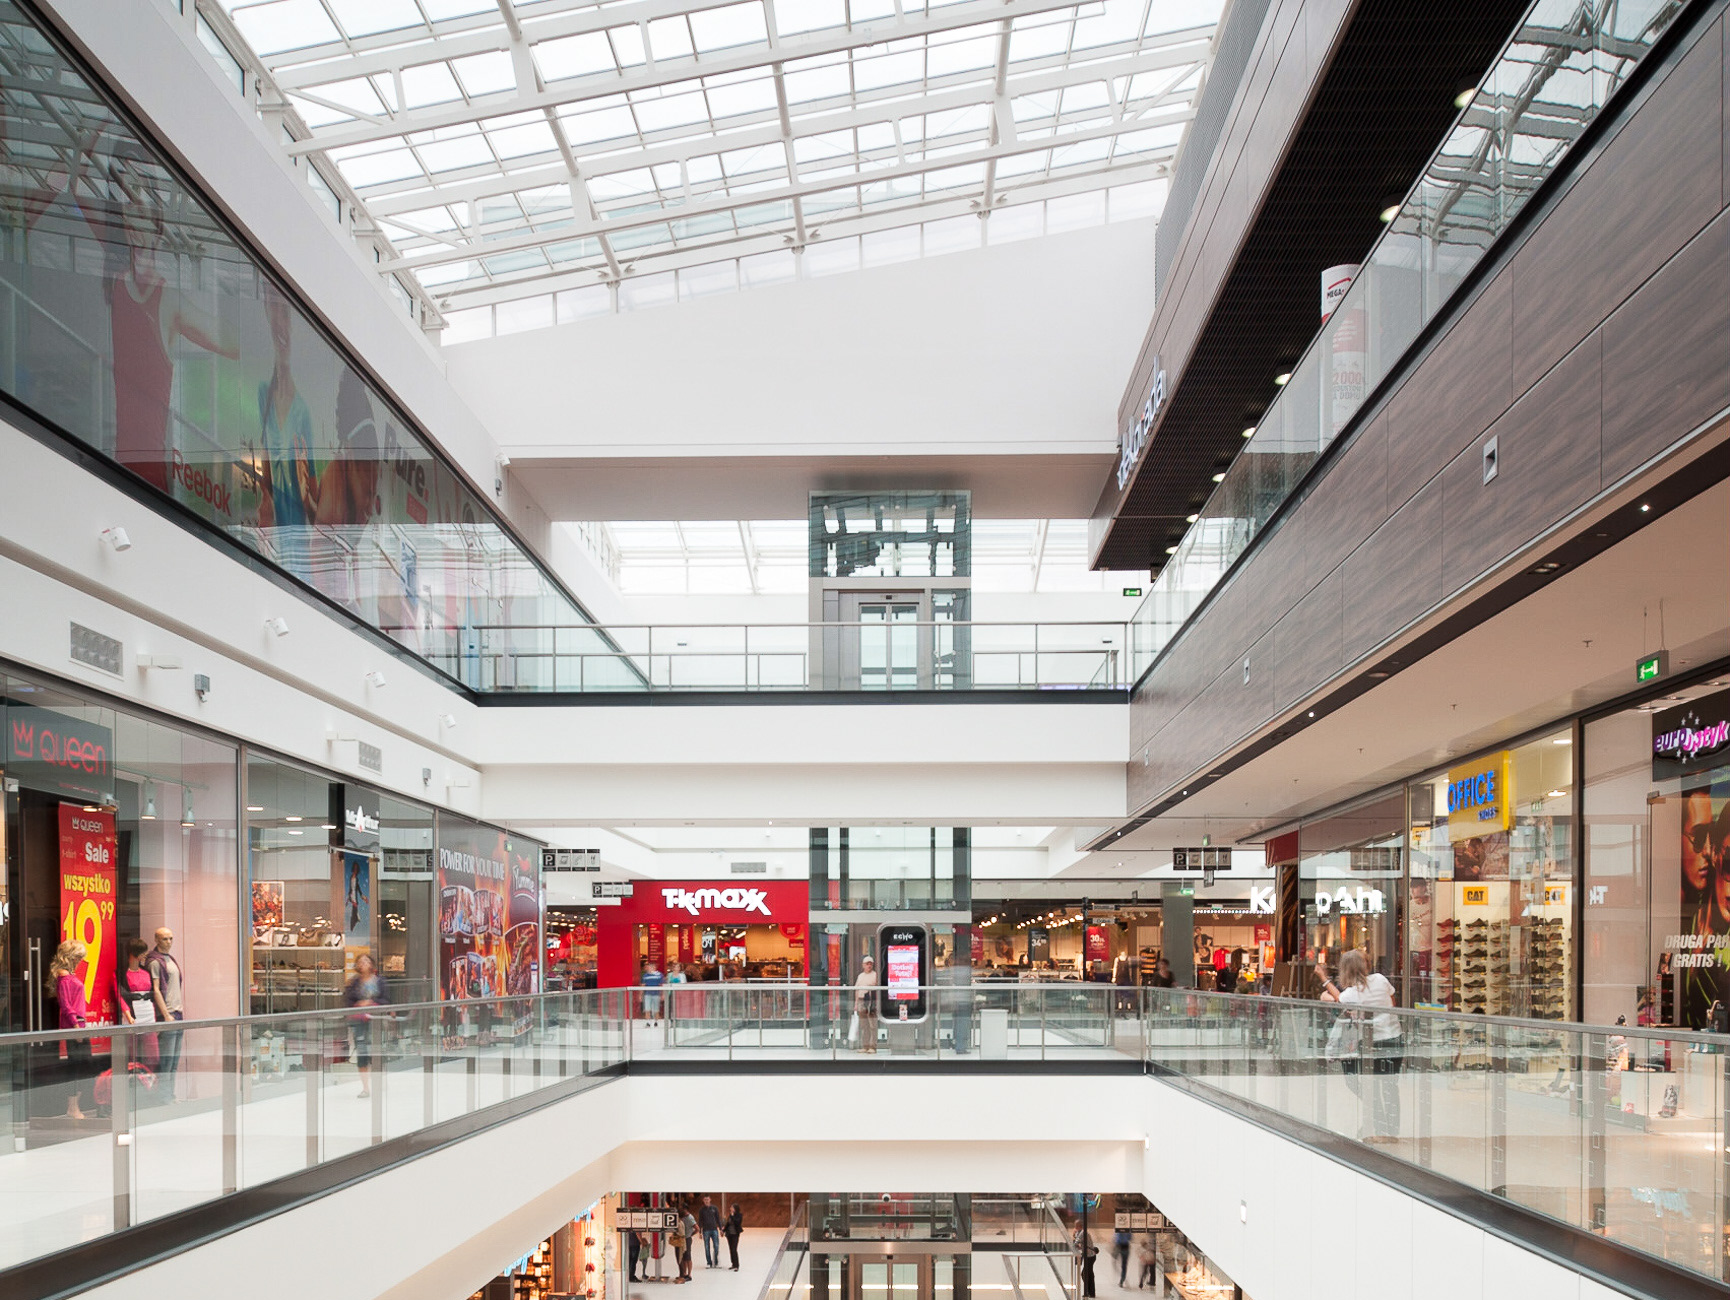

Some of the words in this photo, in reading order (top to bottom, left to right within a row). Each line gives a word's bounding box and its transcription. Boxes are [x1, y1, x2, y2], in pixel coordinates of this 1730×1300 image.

[172, 448, 232, 517] Reebok
[1447, 770, 1495, 813] OFFICE
[85, 842, 109, 864] Sale
[440, 848, 463, 872] POWER
[463, 853, 475, 875] FOR
[475, 856, 492, 878] YOUR
[492, 861, 505, 880] TIME
[63, 873, 111, 897] wszystko
[1467, 890, 1484, 901] CAT
[893, 933, 913, 941] ECHO
[1664, 934, 1704, 950] DRUGA
[1673, 953, 1714, 968] GRATIS
